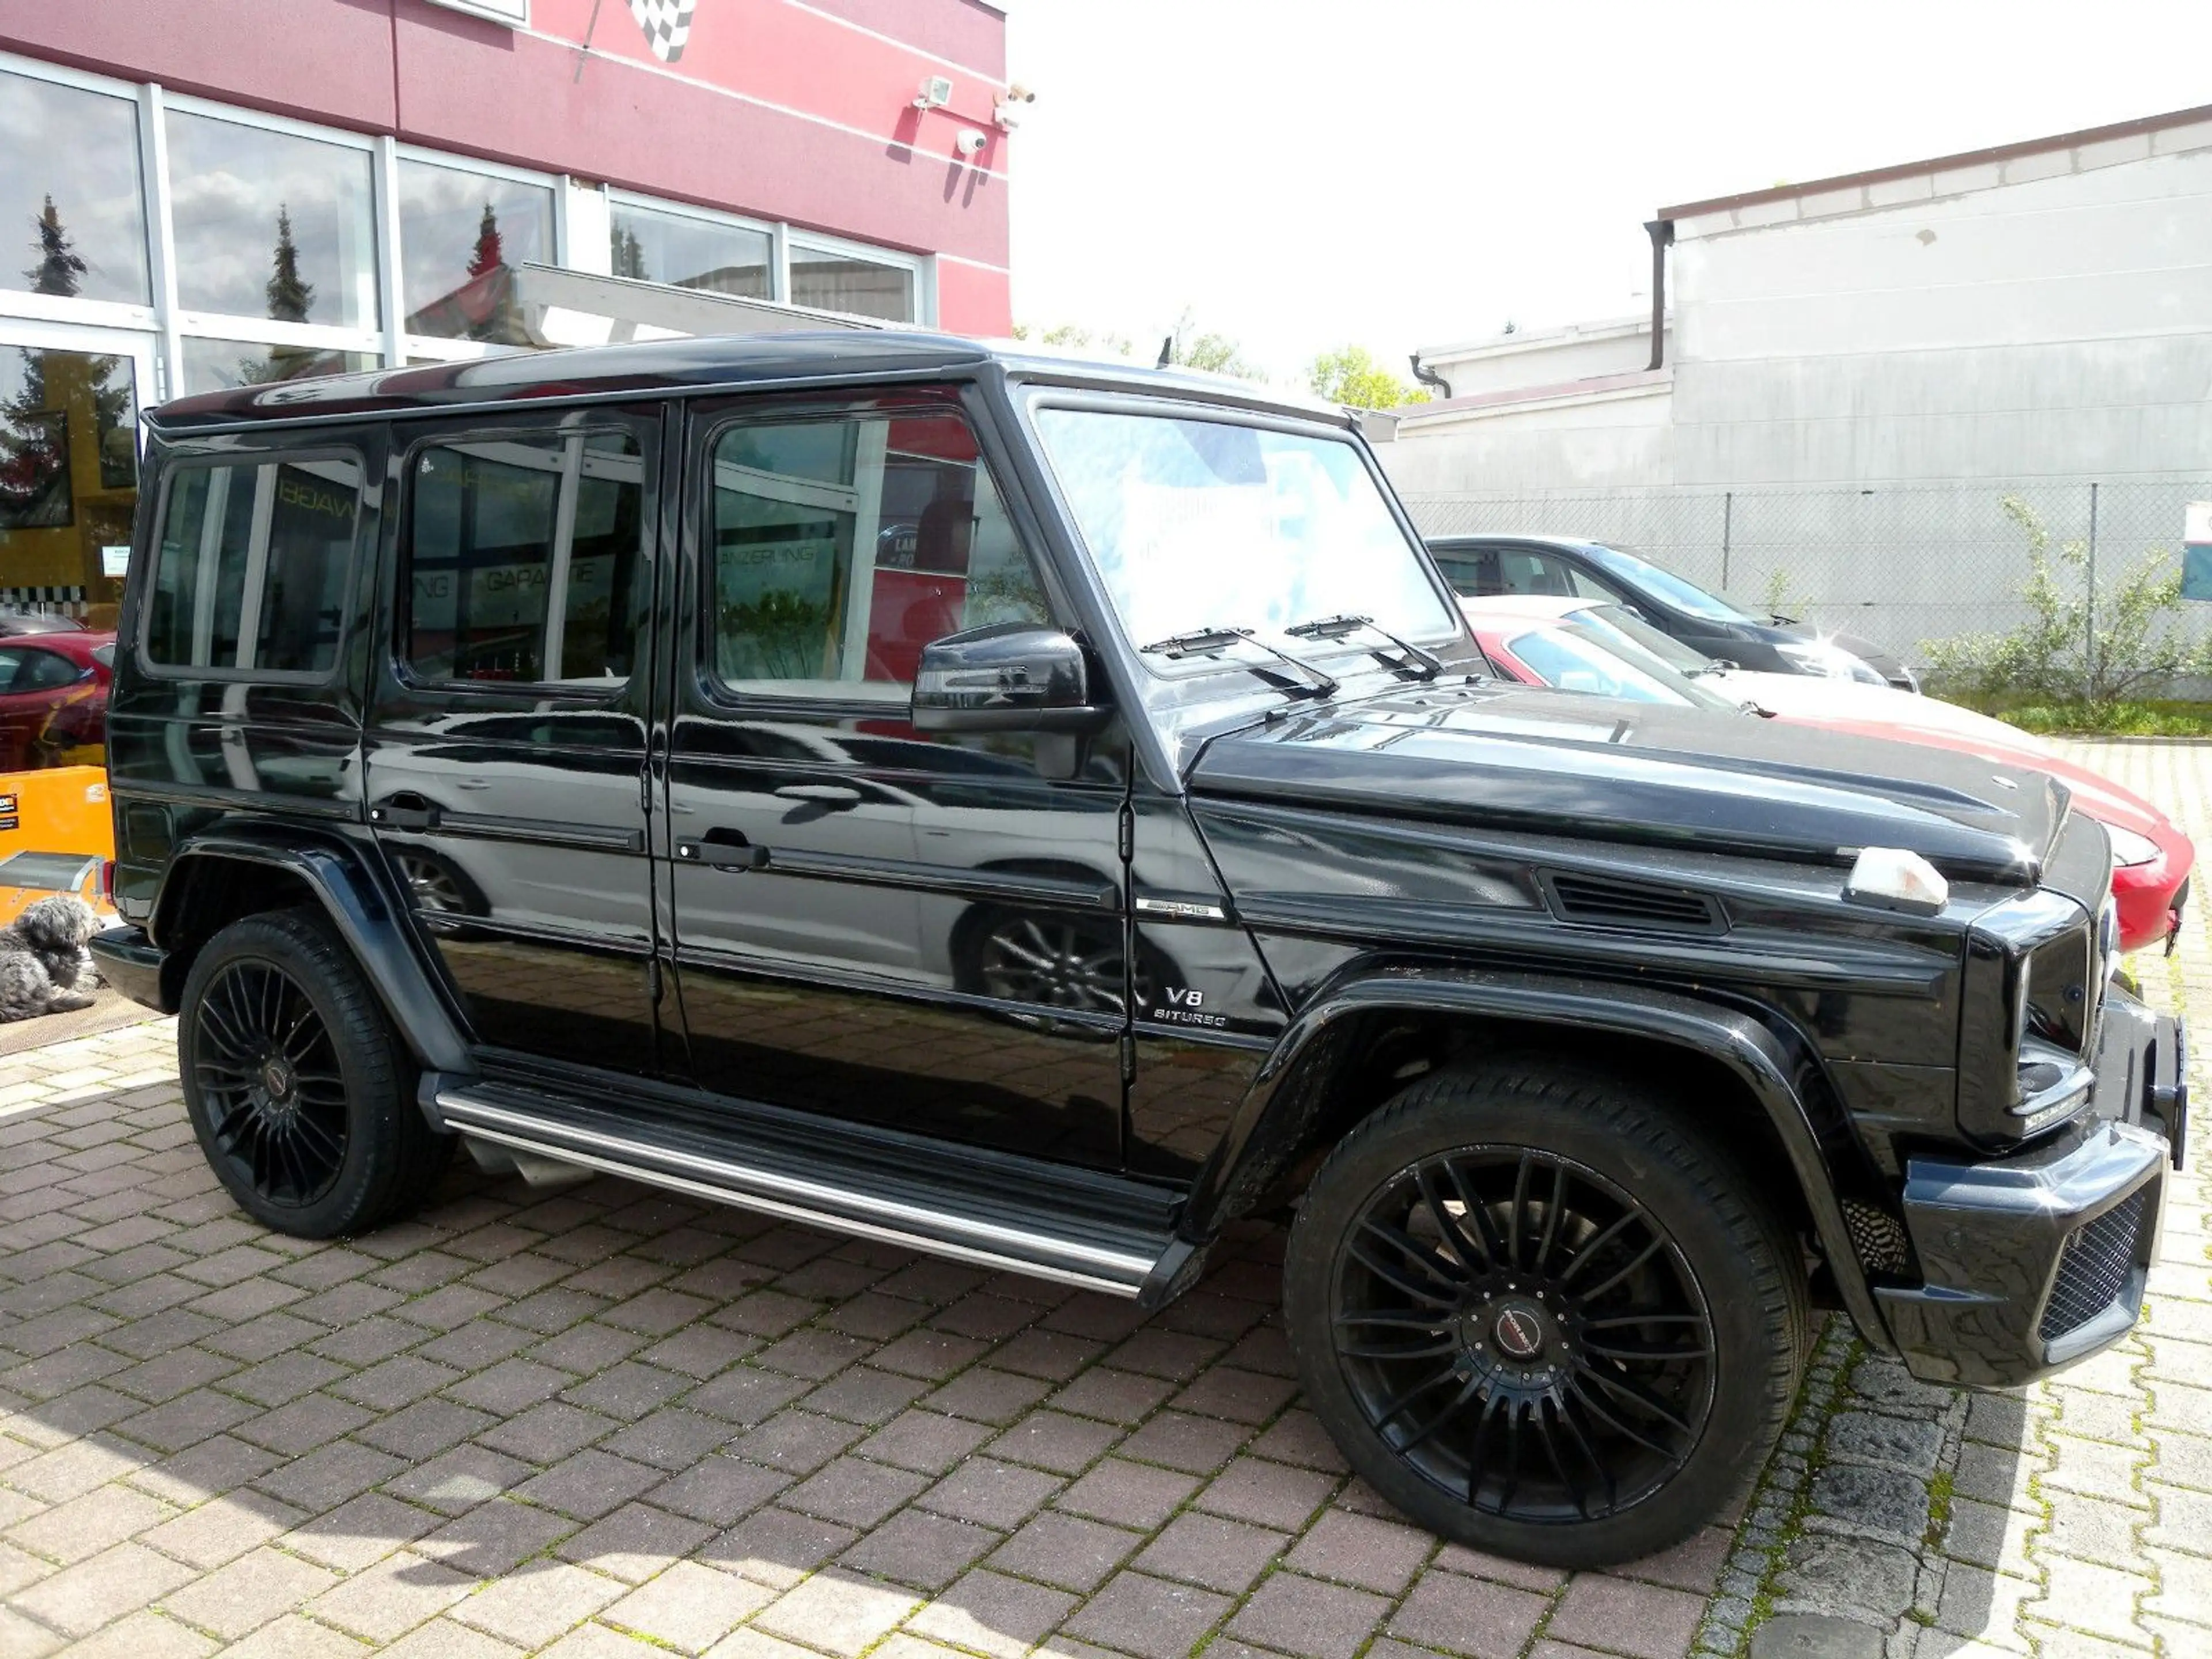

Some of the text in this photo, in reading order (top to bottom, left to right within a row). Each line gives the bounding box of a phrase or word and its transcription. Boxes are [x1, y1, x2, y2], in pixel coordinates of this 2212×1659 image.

[1167, 902, 1209, 915] AMG
[1165, 987, 1203, 1006] V8
[1154, 1009, 1226, 1027] BITURBO
